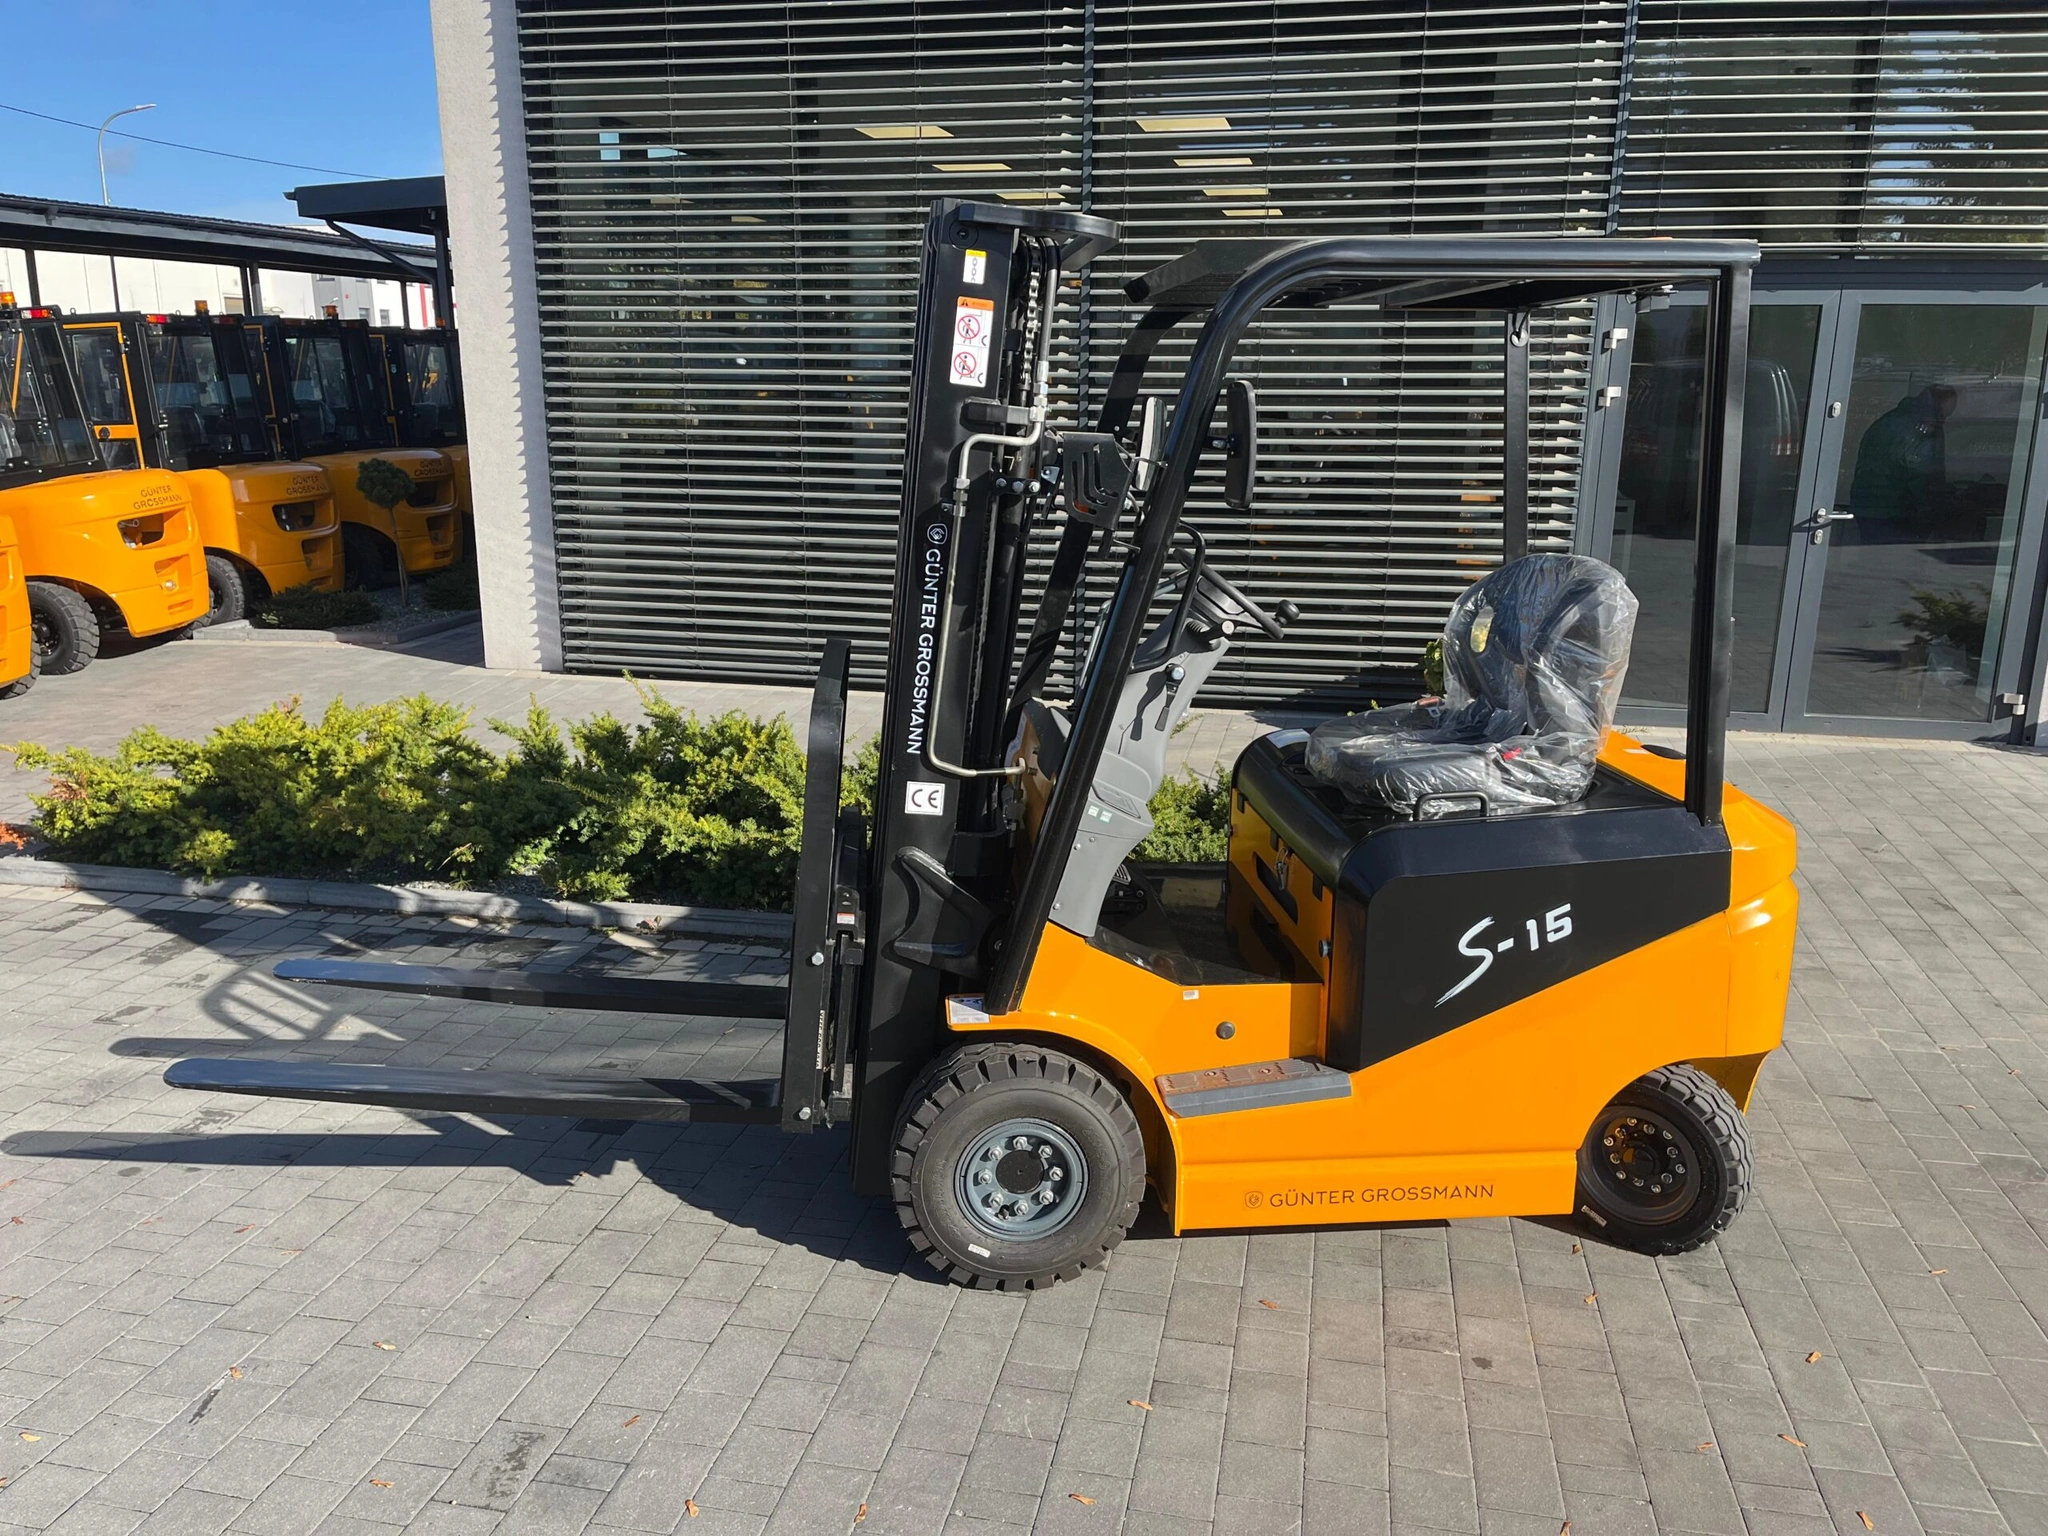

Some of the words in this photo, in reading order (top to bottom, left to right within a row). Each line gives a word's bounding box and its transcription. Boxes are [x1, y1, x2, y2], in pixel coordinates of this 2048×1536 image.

[133, 494, 182, 510] GROSSMANN
[140, 485, 172, 498] GÜNTER
[920, 548, 944, 630] GÜNTER
[906, 632, 934, 755] GROSSMANN
[911, 789, 939, 809] CE
[1269, 1189, 1355, 1208] GÜNTER
[1361, 1184, 1494, 1204] GROSSMANN
